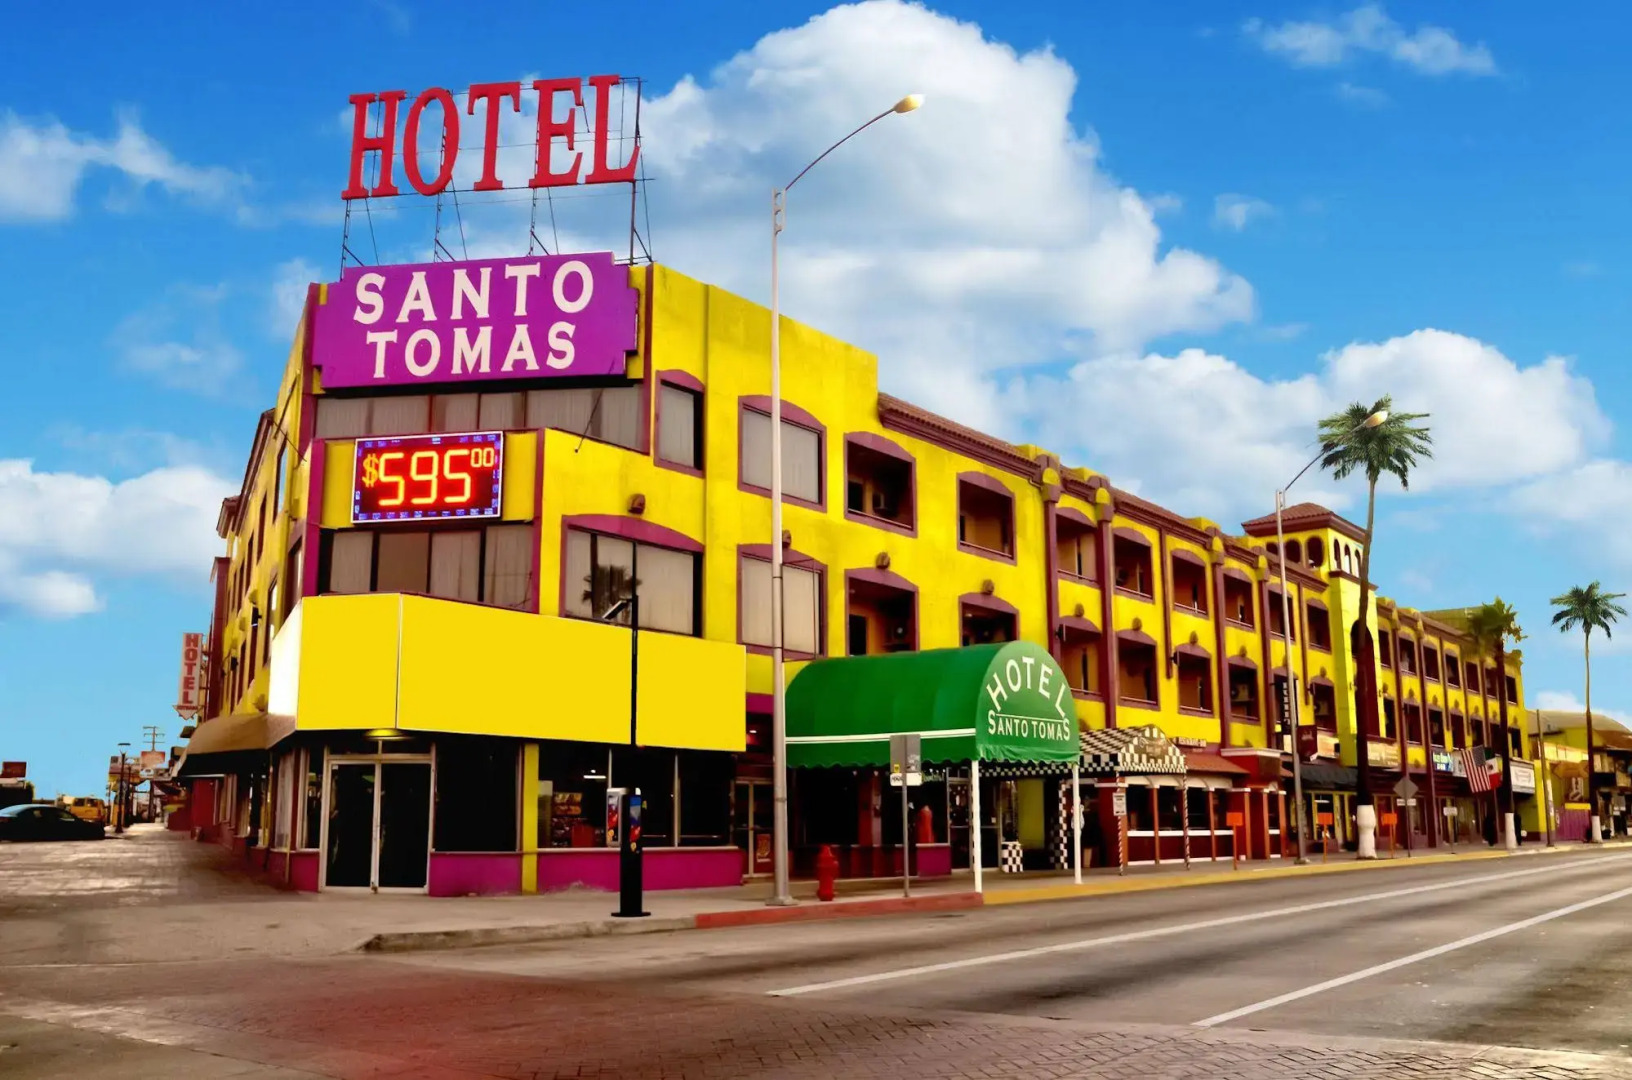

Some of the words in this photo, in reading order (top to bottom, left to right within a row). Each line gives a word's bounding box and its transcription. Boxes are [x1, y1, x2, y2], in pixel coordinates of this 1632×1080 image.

[341, 74, 640, 200] HOTEL
[353, 260, 594, 324] SANTO
[365, 322, 577, 378] TOMAS
[182, 633, 199, 704] HOTEL
[986, 655, 1067, 718] HOTEL
[988, 709, 1028, 737] SANTO
[1031, 717, 1071, 741] TOMAS
